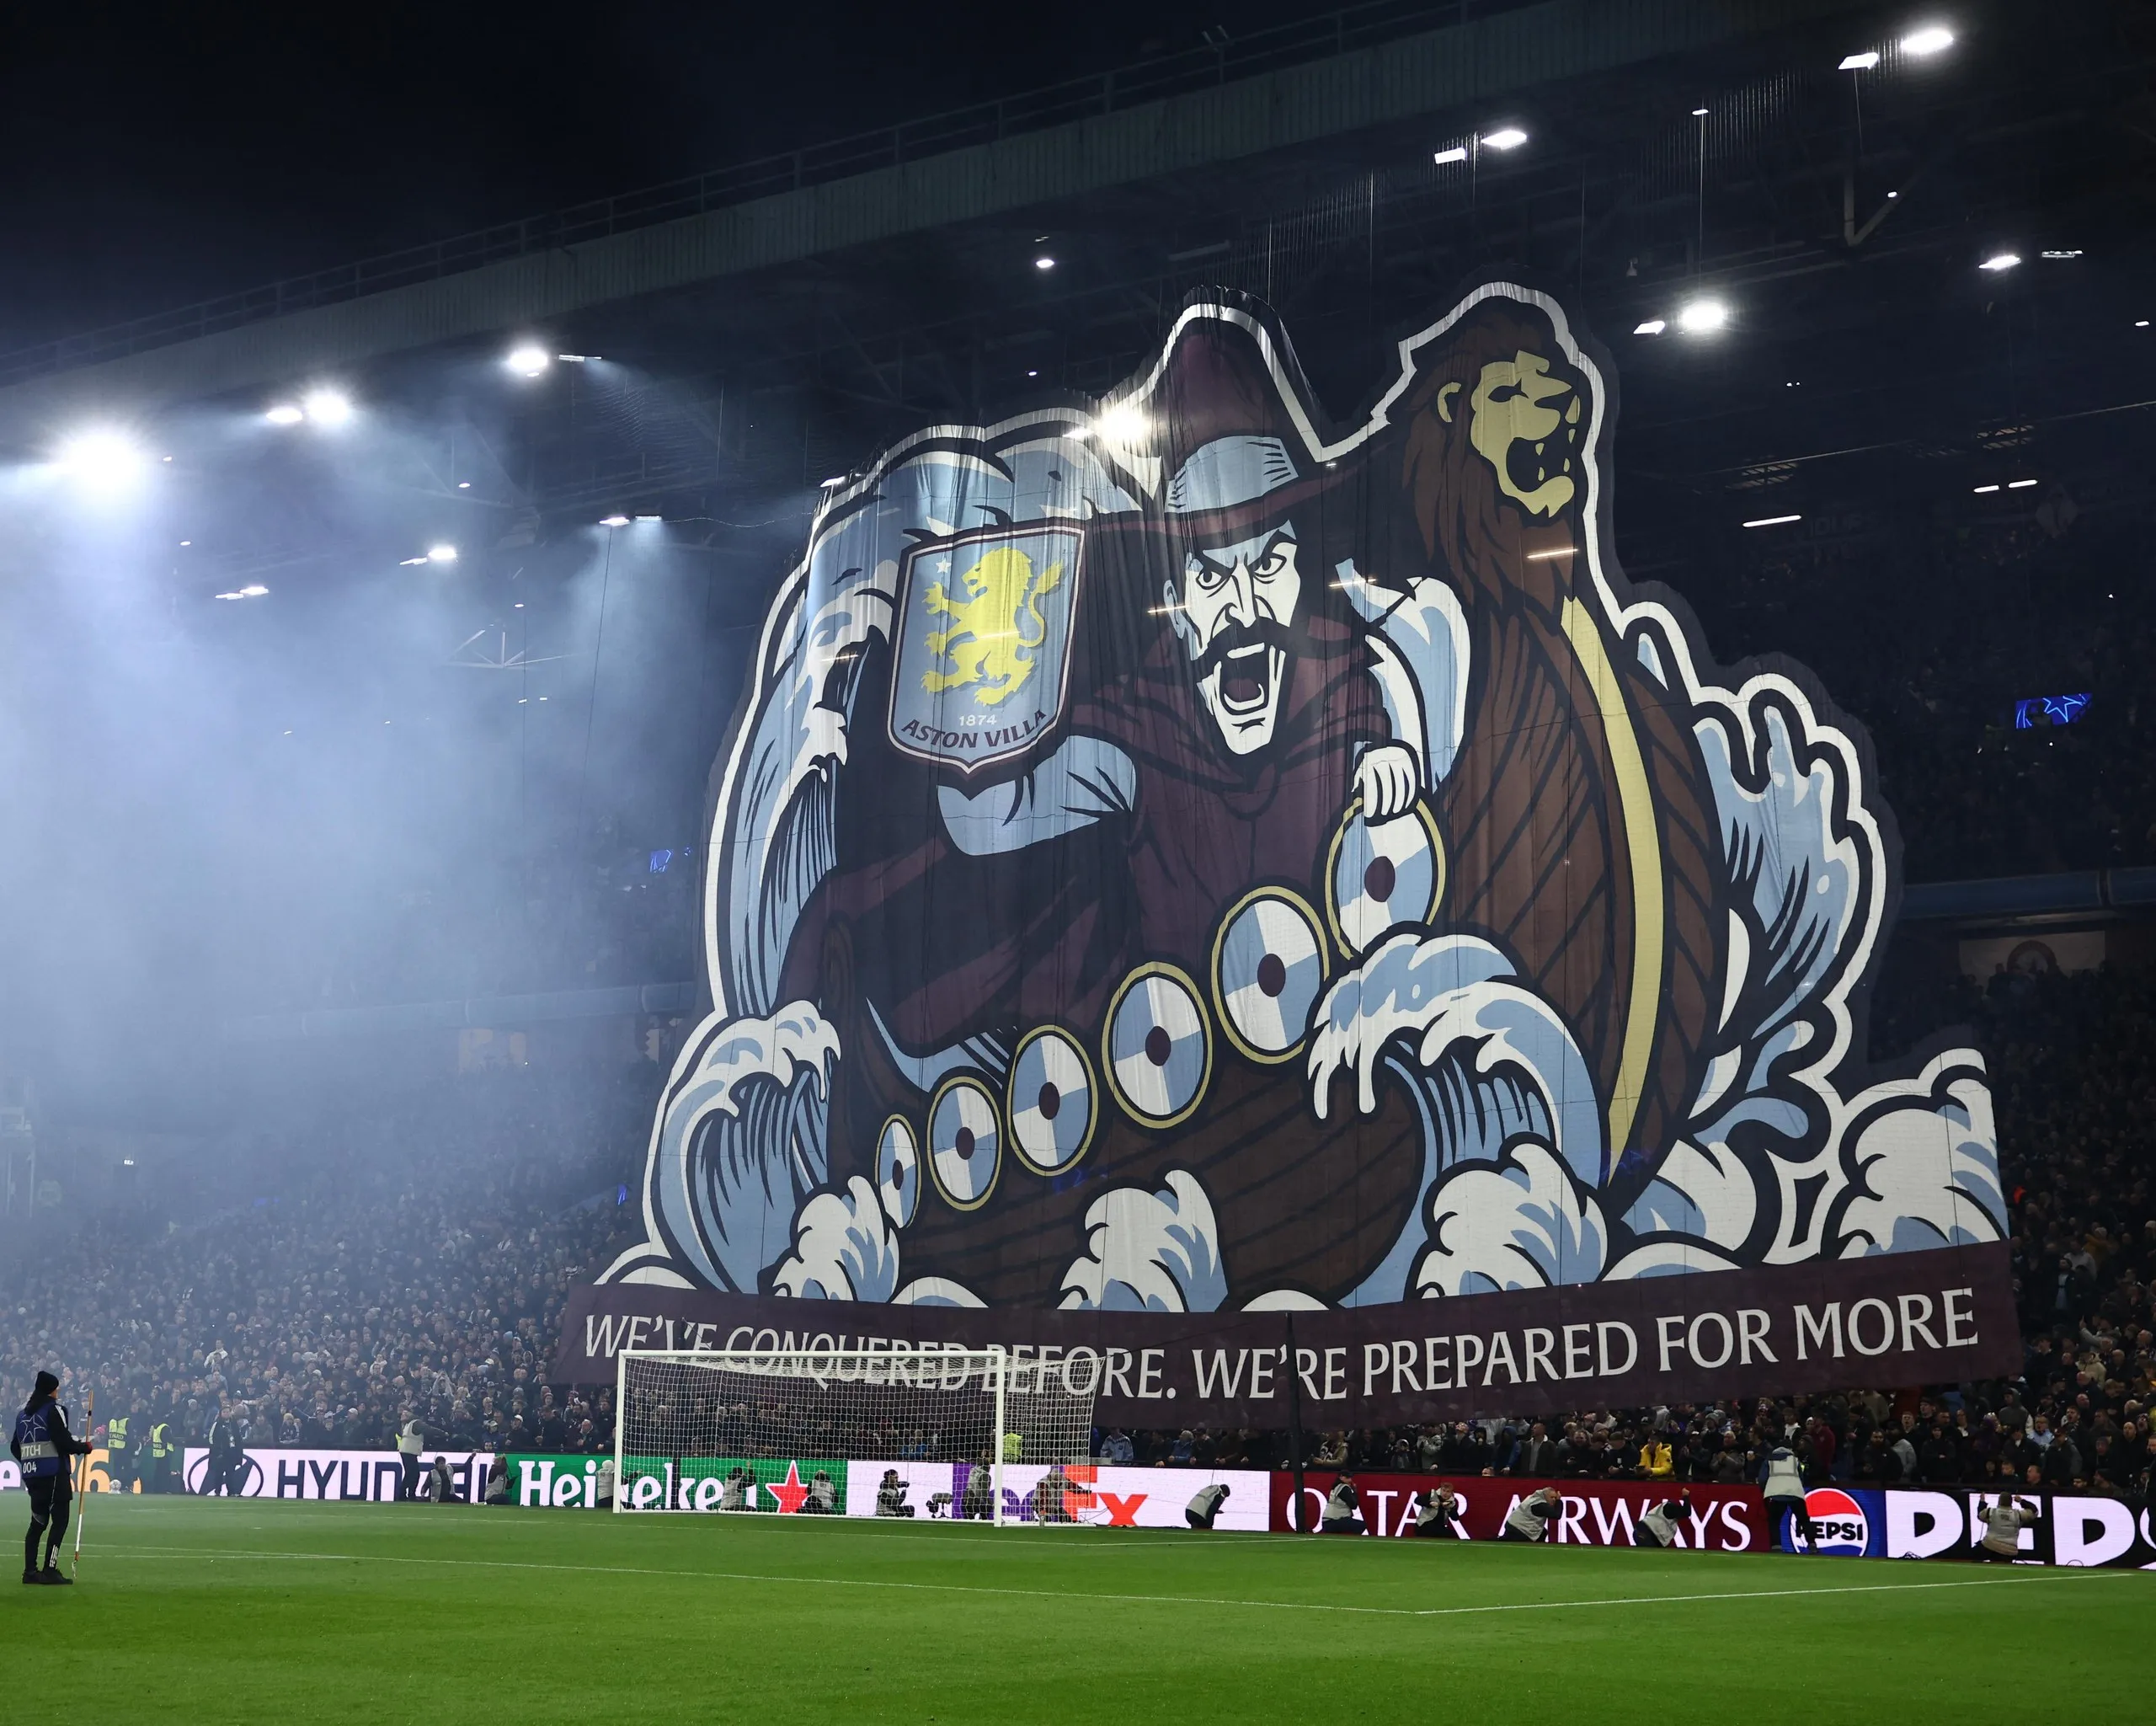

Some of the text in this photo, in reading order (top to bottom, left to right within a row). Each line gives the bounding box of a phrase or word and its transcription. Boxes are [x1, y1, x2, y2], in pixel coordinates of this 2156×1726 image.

[901, 709, 1046, 748] ASTON VILLA
[959, 714, 997, 726] 1874
[724, 1326, 969, 1391] CONQUERED
[981, 1343, 1177, 1400] BEFORE.
[1193, 1343, 1348, 1400] WE'RE
[1363, 1322, 1638, 1397] PREPARED
[1656, 1309, 1780, 1371] FOR
[1794, 1288, 1979, 1360] MORE
